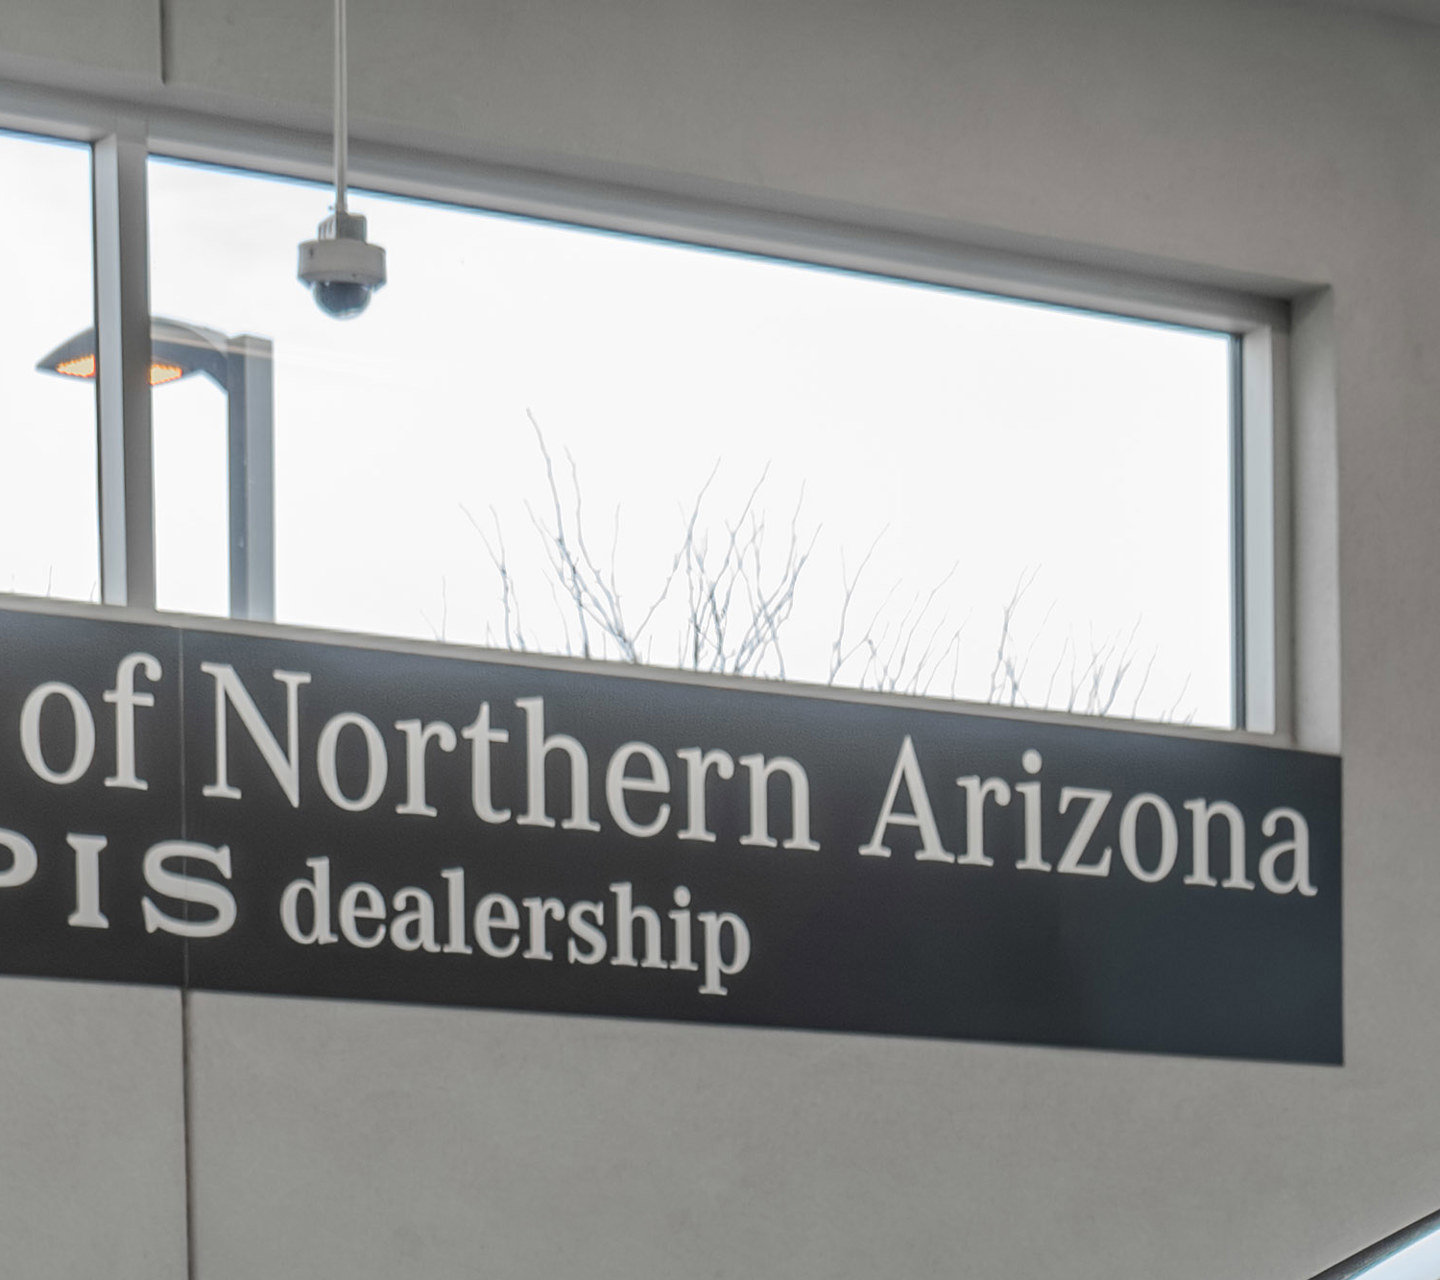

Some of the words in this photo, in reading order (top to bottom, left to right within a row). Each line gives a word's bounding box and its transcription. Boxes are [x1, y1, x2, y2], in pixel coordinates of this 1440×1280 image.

[19, 652, 163, 791] of
[200, 661, 821, 852] Northern
[858, 734, 1318, 896] Arizona
[280, 856, 750, 996] dealership
